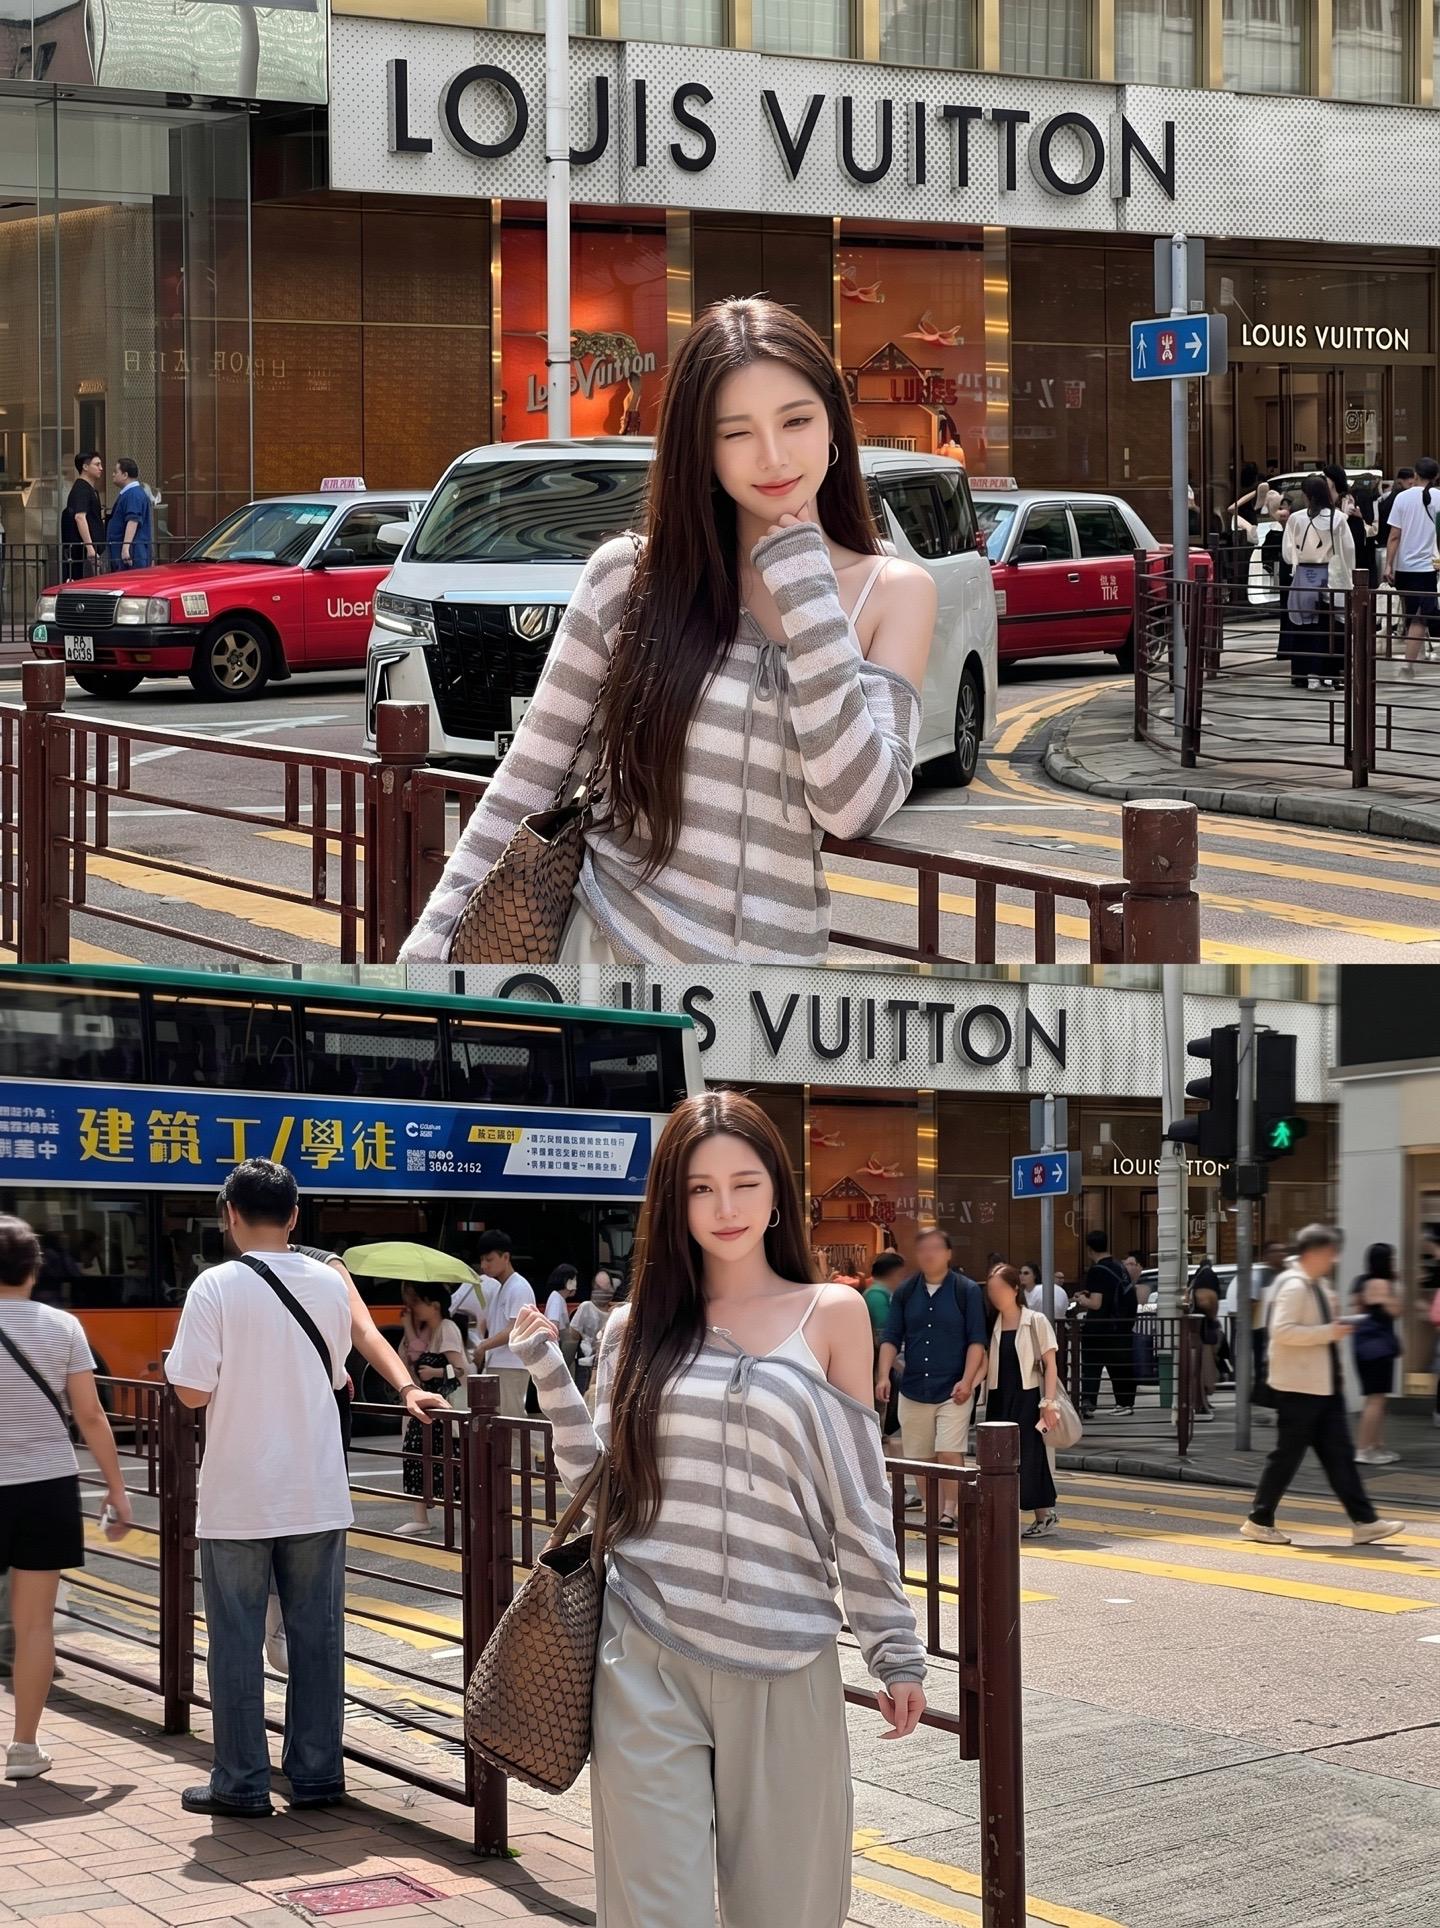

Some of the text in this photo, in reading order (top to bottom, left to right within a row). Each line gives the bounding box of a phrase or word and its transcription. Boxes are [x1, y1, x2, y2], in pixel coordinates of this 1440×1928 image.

[387, 58, 1177, 201] LOUIS VUITTON
[1242, 323, 1409, 350] LOUIS VUITTON
[327, 598, 372, 618] Uber
[750, 990, 1067, 1070] VUITTON
[457, 1162, 481, 1173] 2152
